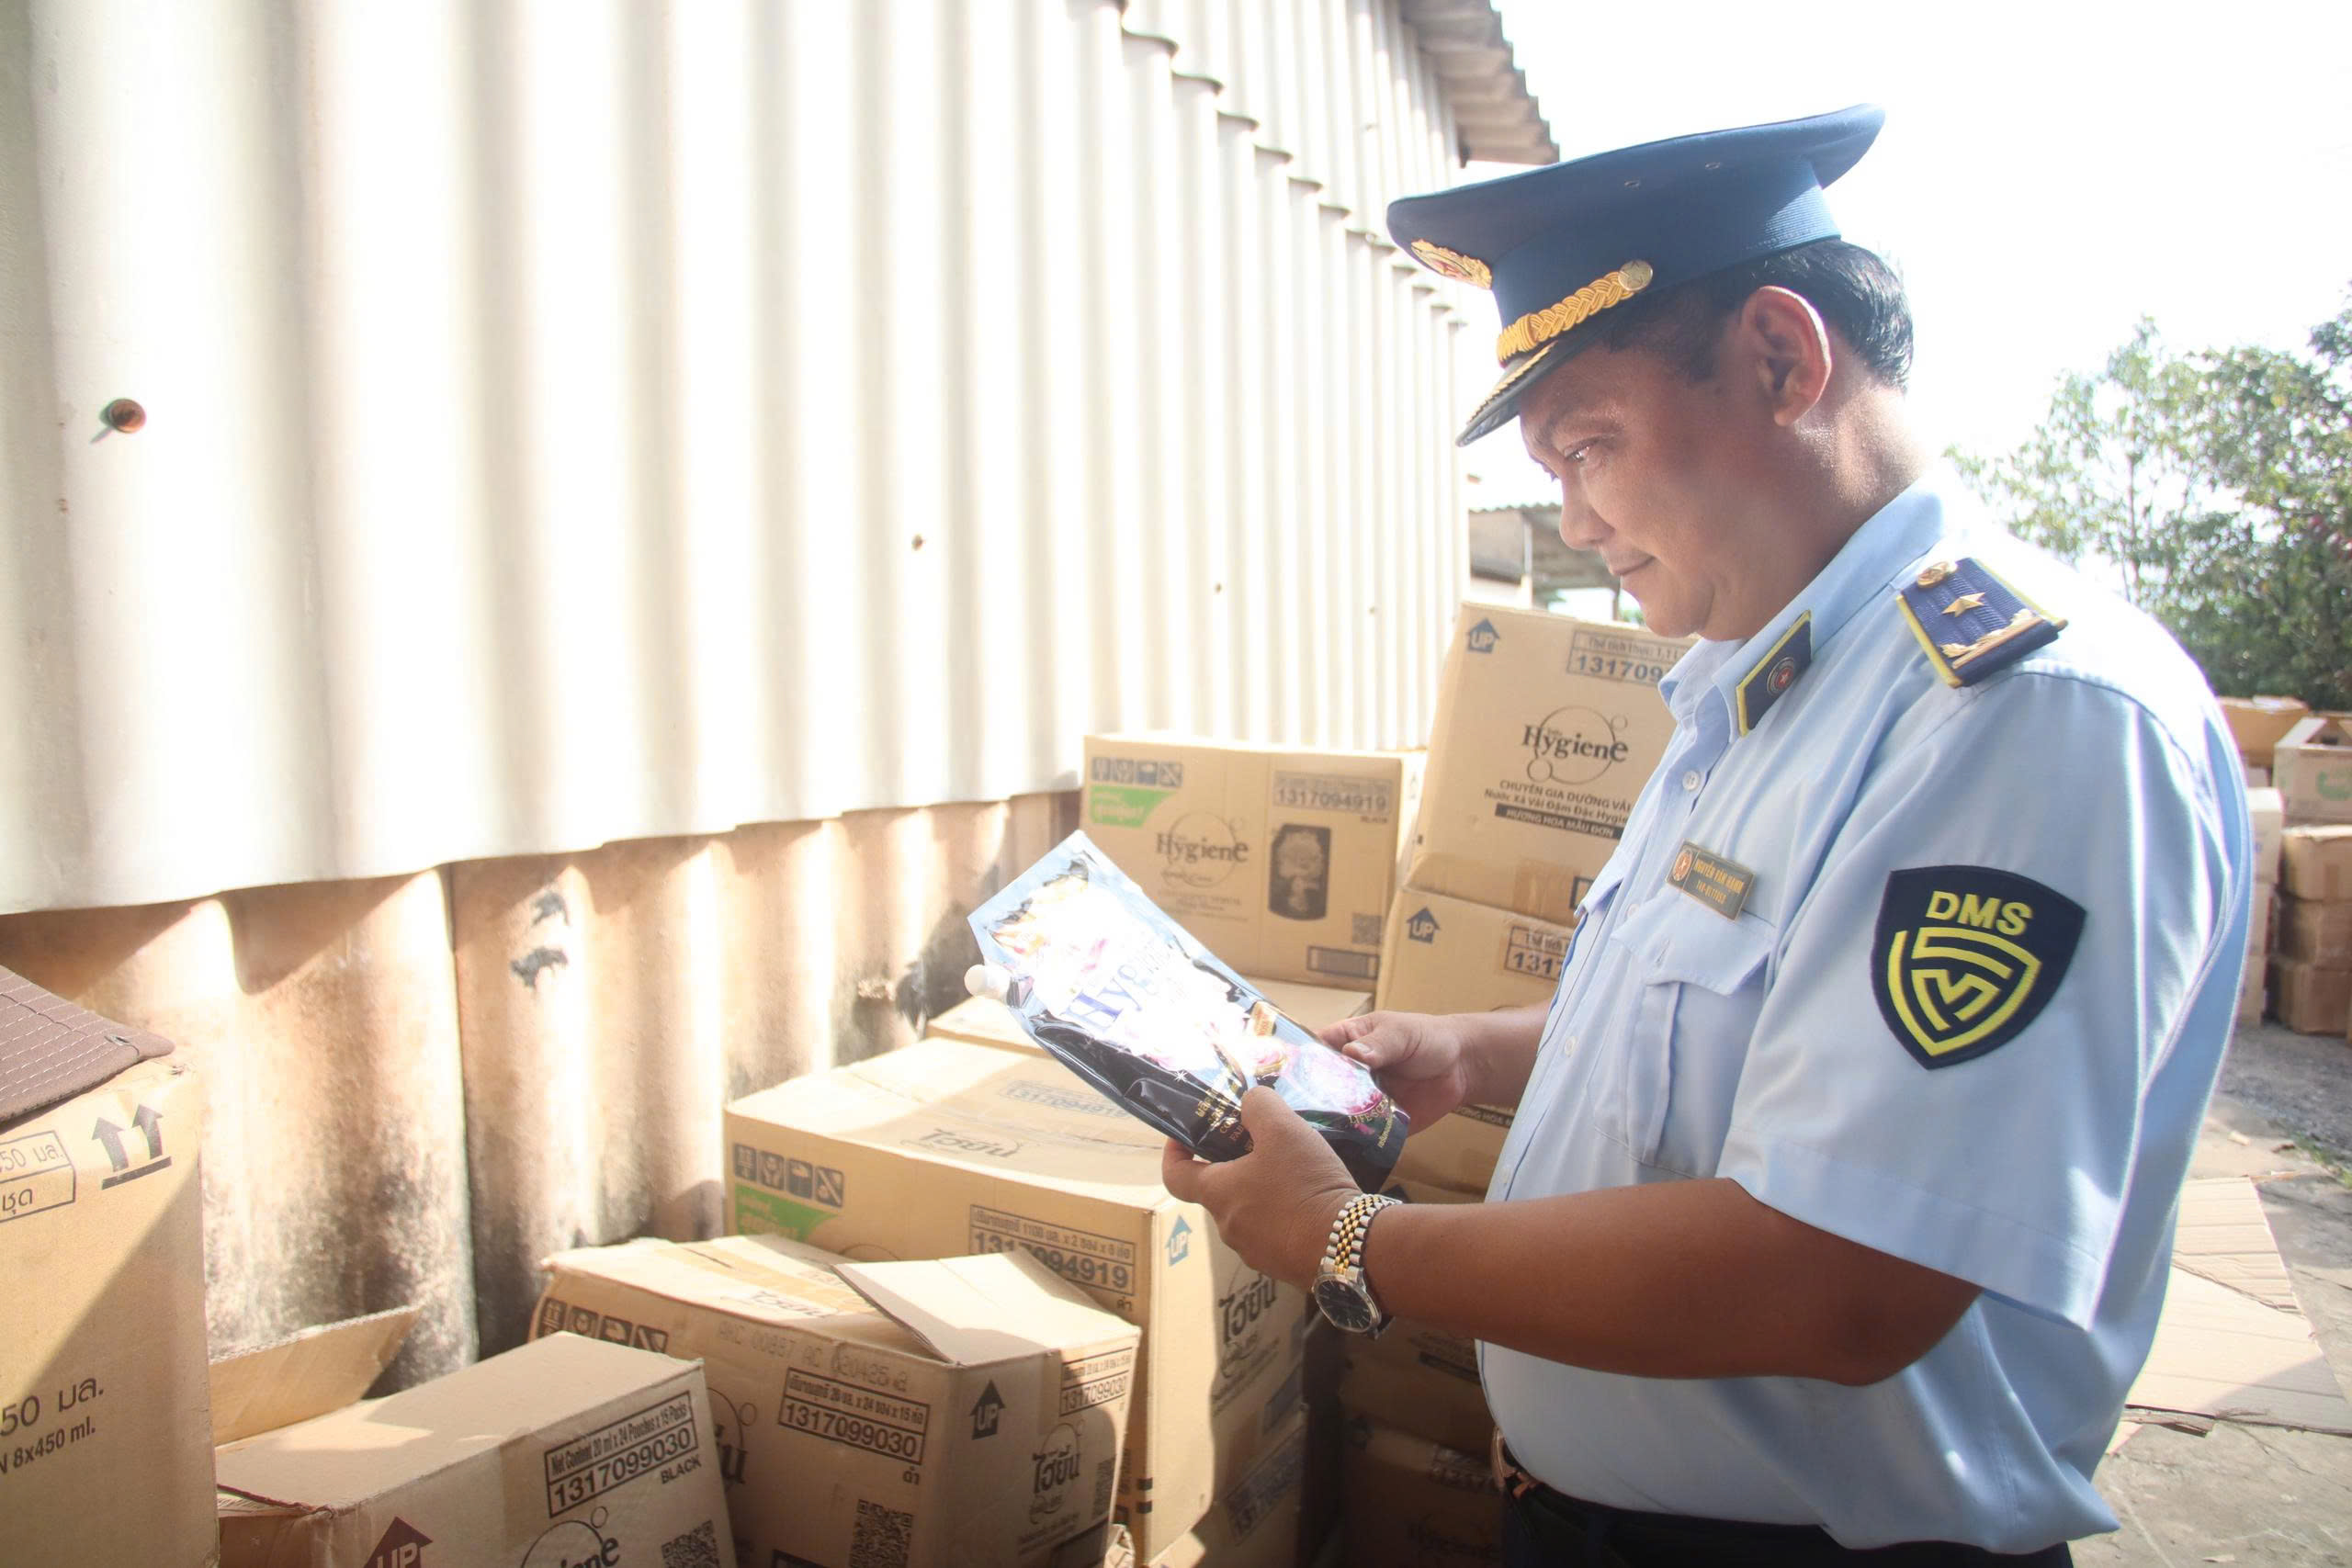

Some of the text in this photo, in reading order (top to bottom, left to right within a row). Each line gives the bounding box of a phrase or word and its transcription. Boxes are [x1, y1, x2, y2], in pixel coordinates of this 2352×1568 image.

[1577, 653, 1668, 683] 131709
[1521, 724, 1629, 763] Hygiene
[1499, 779, 1544, 797] CHUYÊN
[1545, 788, 1566, 801] GIA
[1543, 816, 1564, 829] HOA
[1155, 831, 1250, 863] Hygiene
[1412, 919, 1435, 938] UP
[1926, 890, 2033, 936] DMS
[0, 1147, 27, 1173] 50
[1170, 1231, 1189, 1258] UP
[975, 1232, 1130, 1289] 131094919
[58, 1377, 105, 1413] มล.
[786, 1402, 918, 1459] 1317099030
[977, 1402, 999, 1431] UP
[13, 1427, 66, 1469] 8x450
[70, 1416, 96, 1444] ml.
[553, 1427, 691, 1508] 1317099030
[660, 1454, 703, 1485] BLACK
